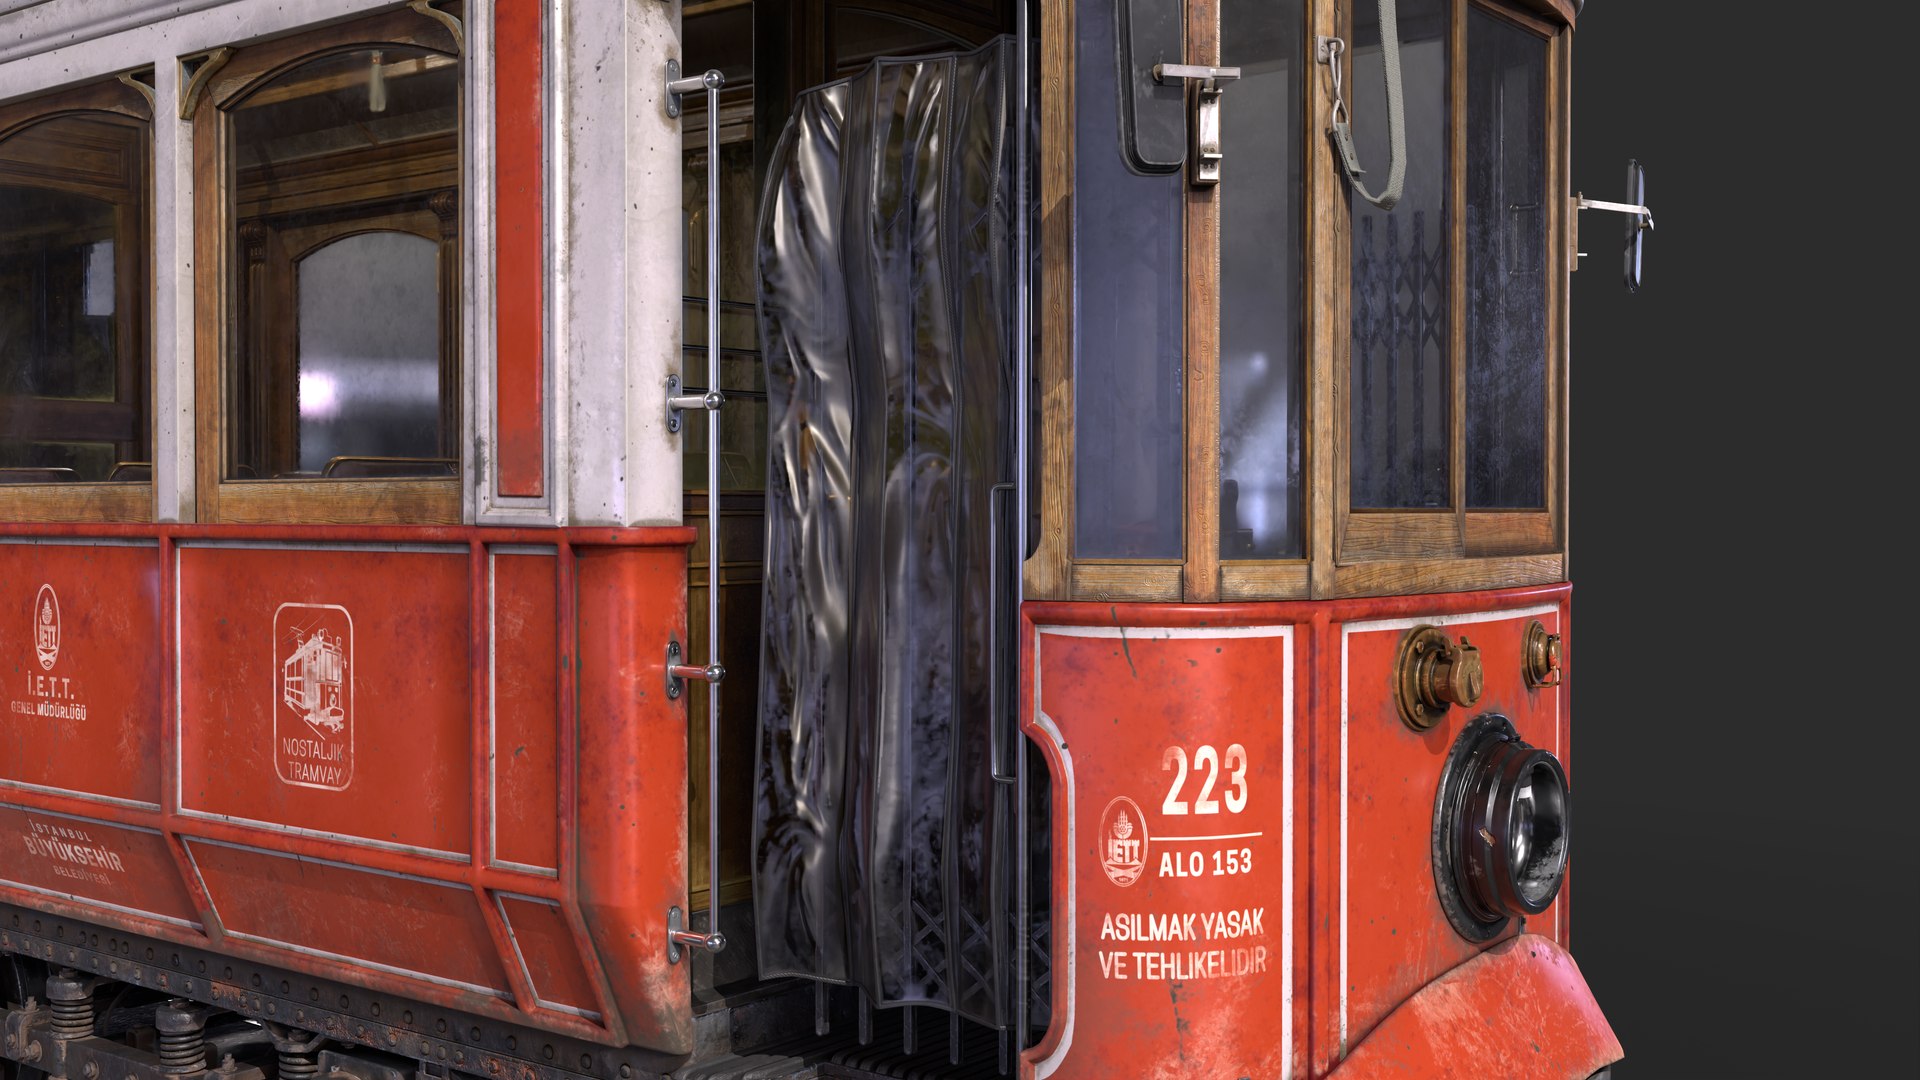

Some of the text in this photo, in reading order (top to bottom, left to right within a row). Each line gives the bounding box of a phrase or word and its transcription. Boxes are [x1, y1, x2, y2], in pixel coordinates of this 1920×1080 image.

[27, 670, 75, 700] İ.E.T.T.
[10, 700, 87, 721] GENEL MÜDÜRLÜĞÜ
[283, 737, 344, 762] NOSTALJIK
[288, 761, 342, 785] TRAMVAY
[1161, 743, 1248, 815] 223
[28, 818, 92, 843] İSTANBUL
[1158, 847, 1252, 878] ALO 153
[1100, 907, 1264, 941] ASILMAK YASAK
[1098, 945, 1267, 981] VE TEHLIKELIDIR
